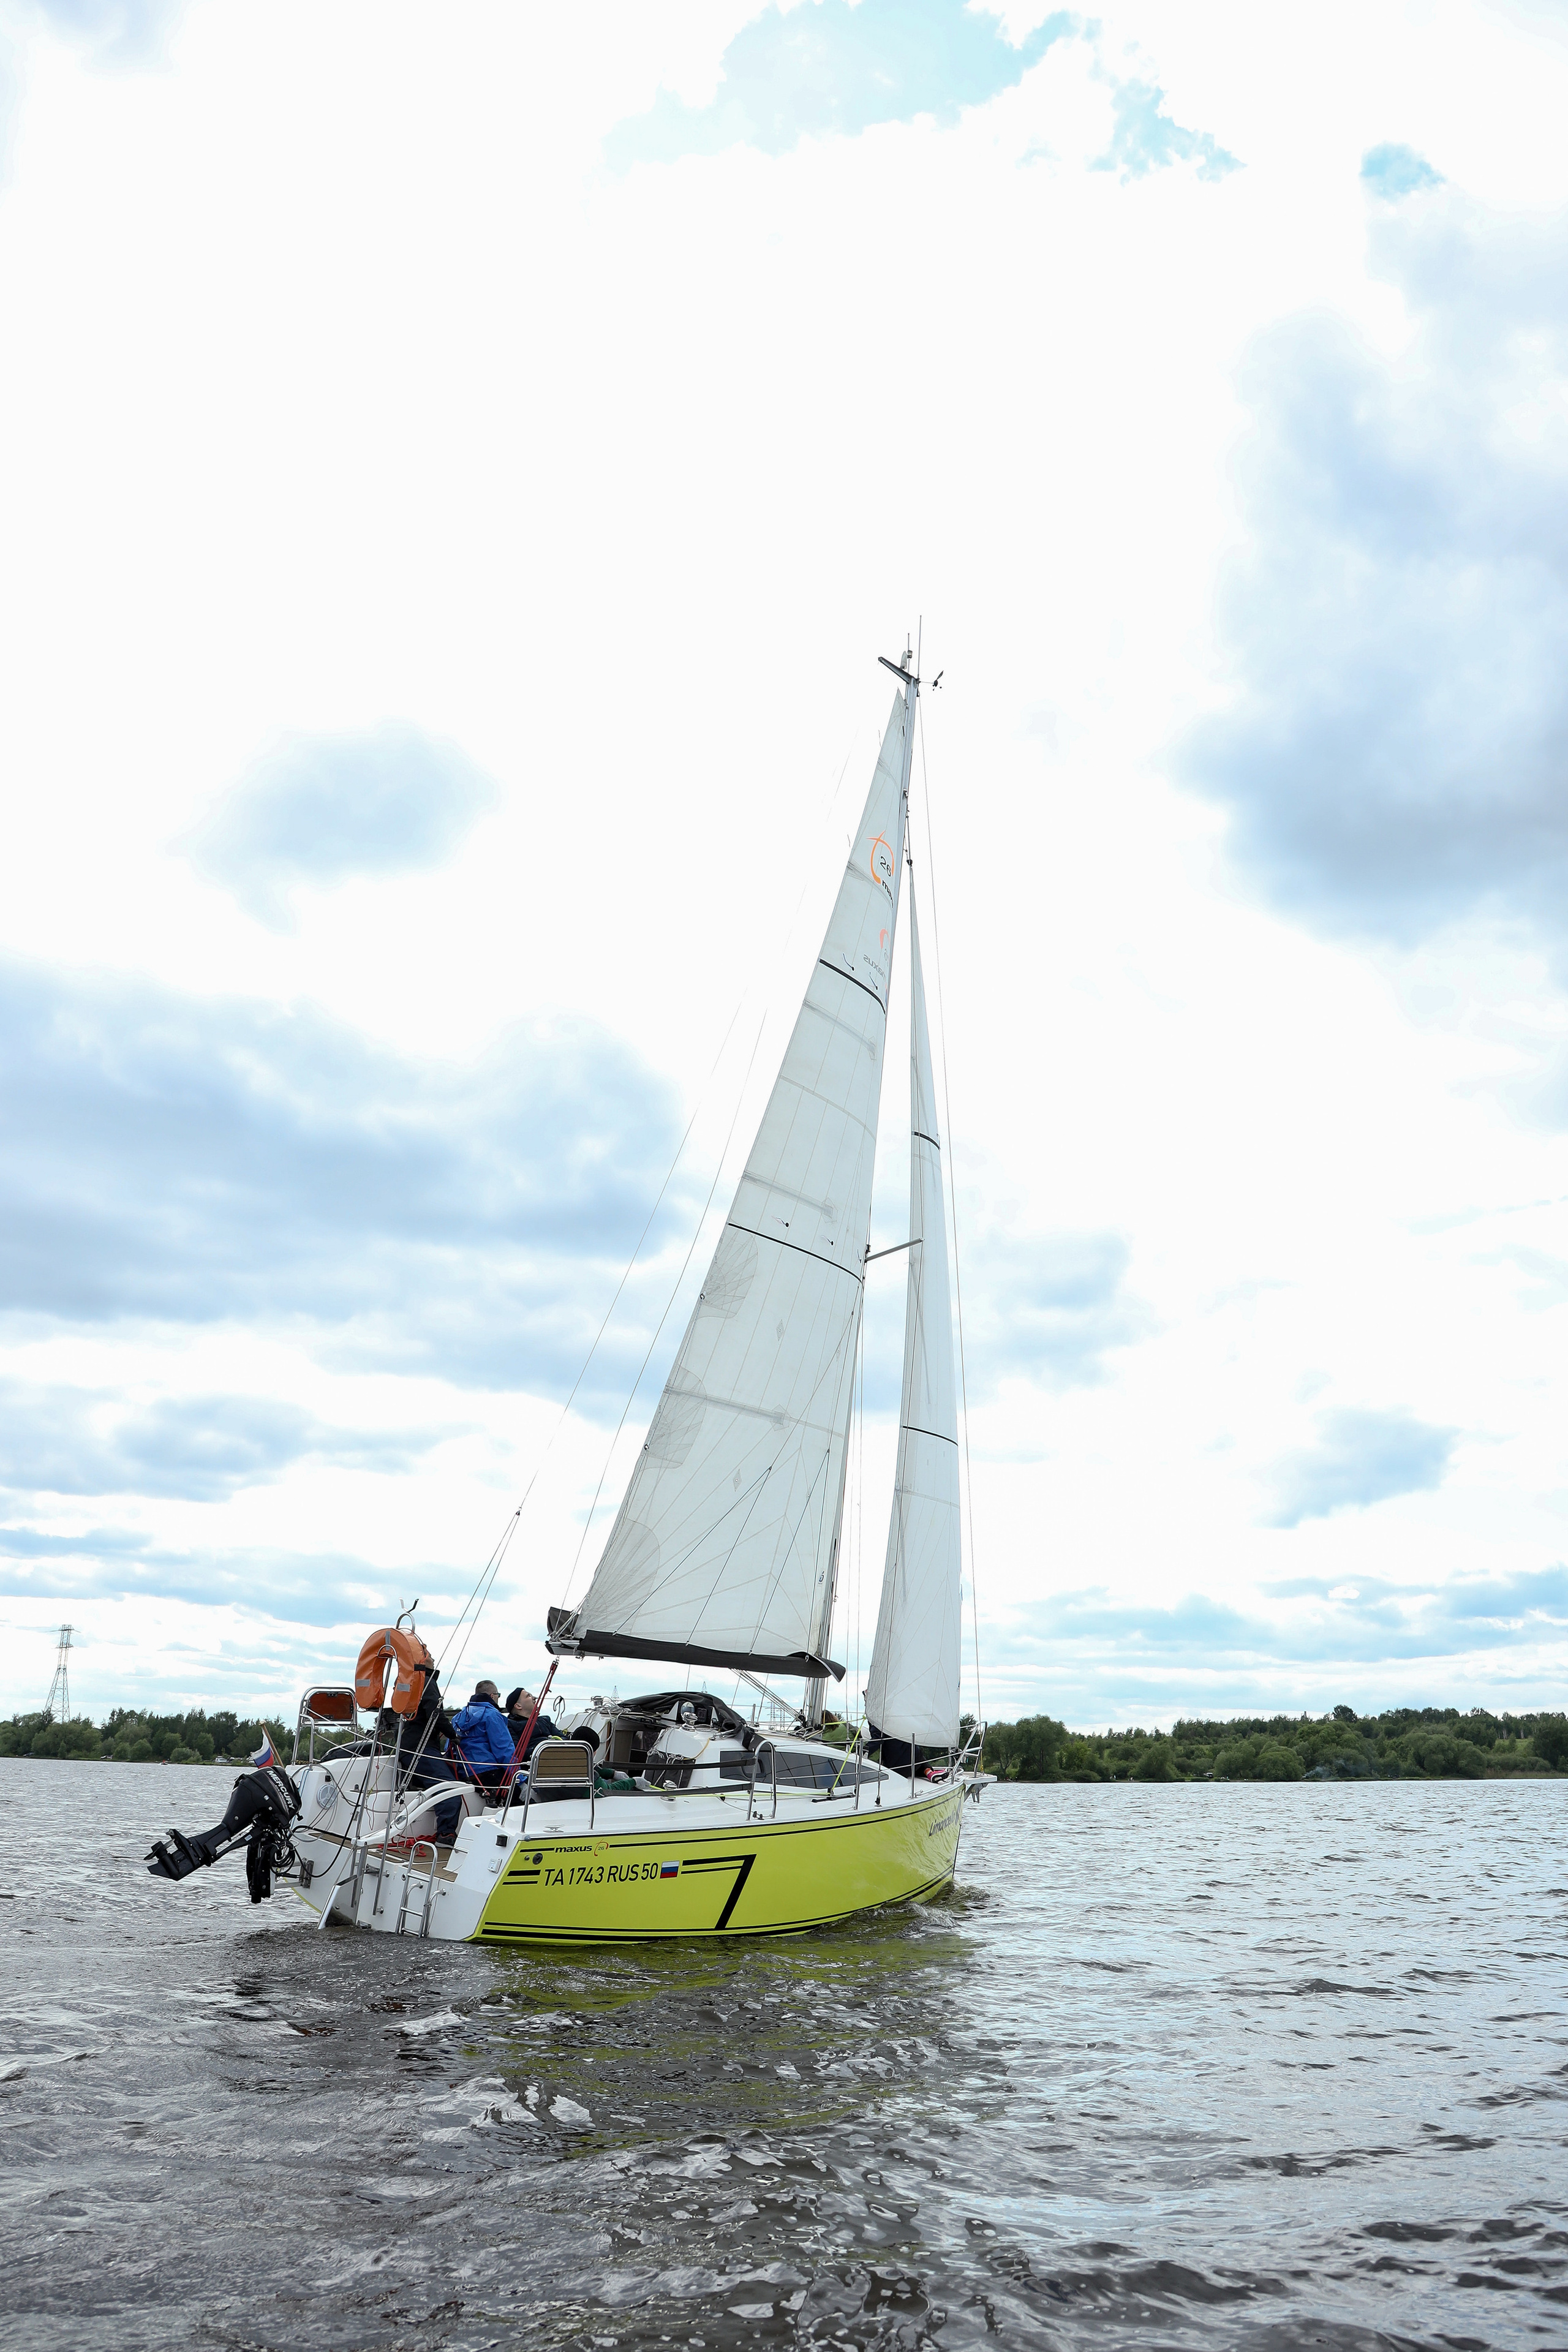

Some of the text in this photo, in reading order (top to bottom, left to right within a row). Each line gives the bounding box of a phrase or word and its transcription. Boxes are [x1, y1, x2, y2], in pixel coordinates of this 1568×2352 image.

[880, 856, 891, 877] 26
[266, 1770, 295, 1810] MERCURY
[545, 1862, 658, 1887] TA 1743 RUS 50
